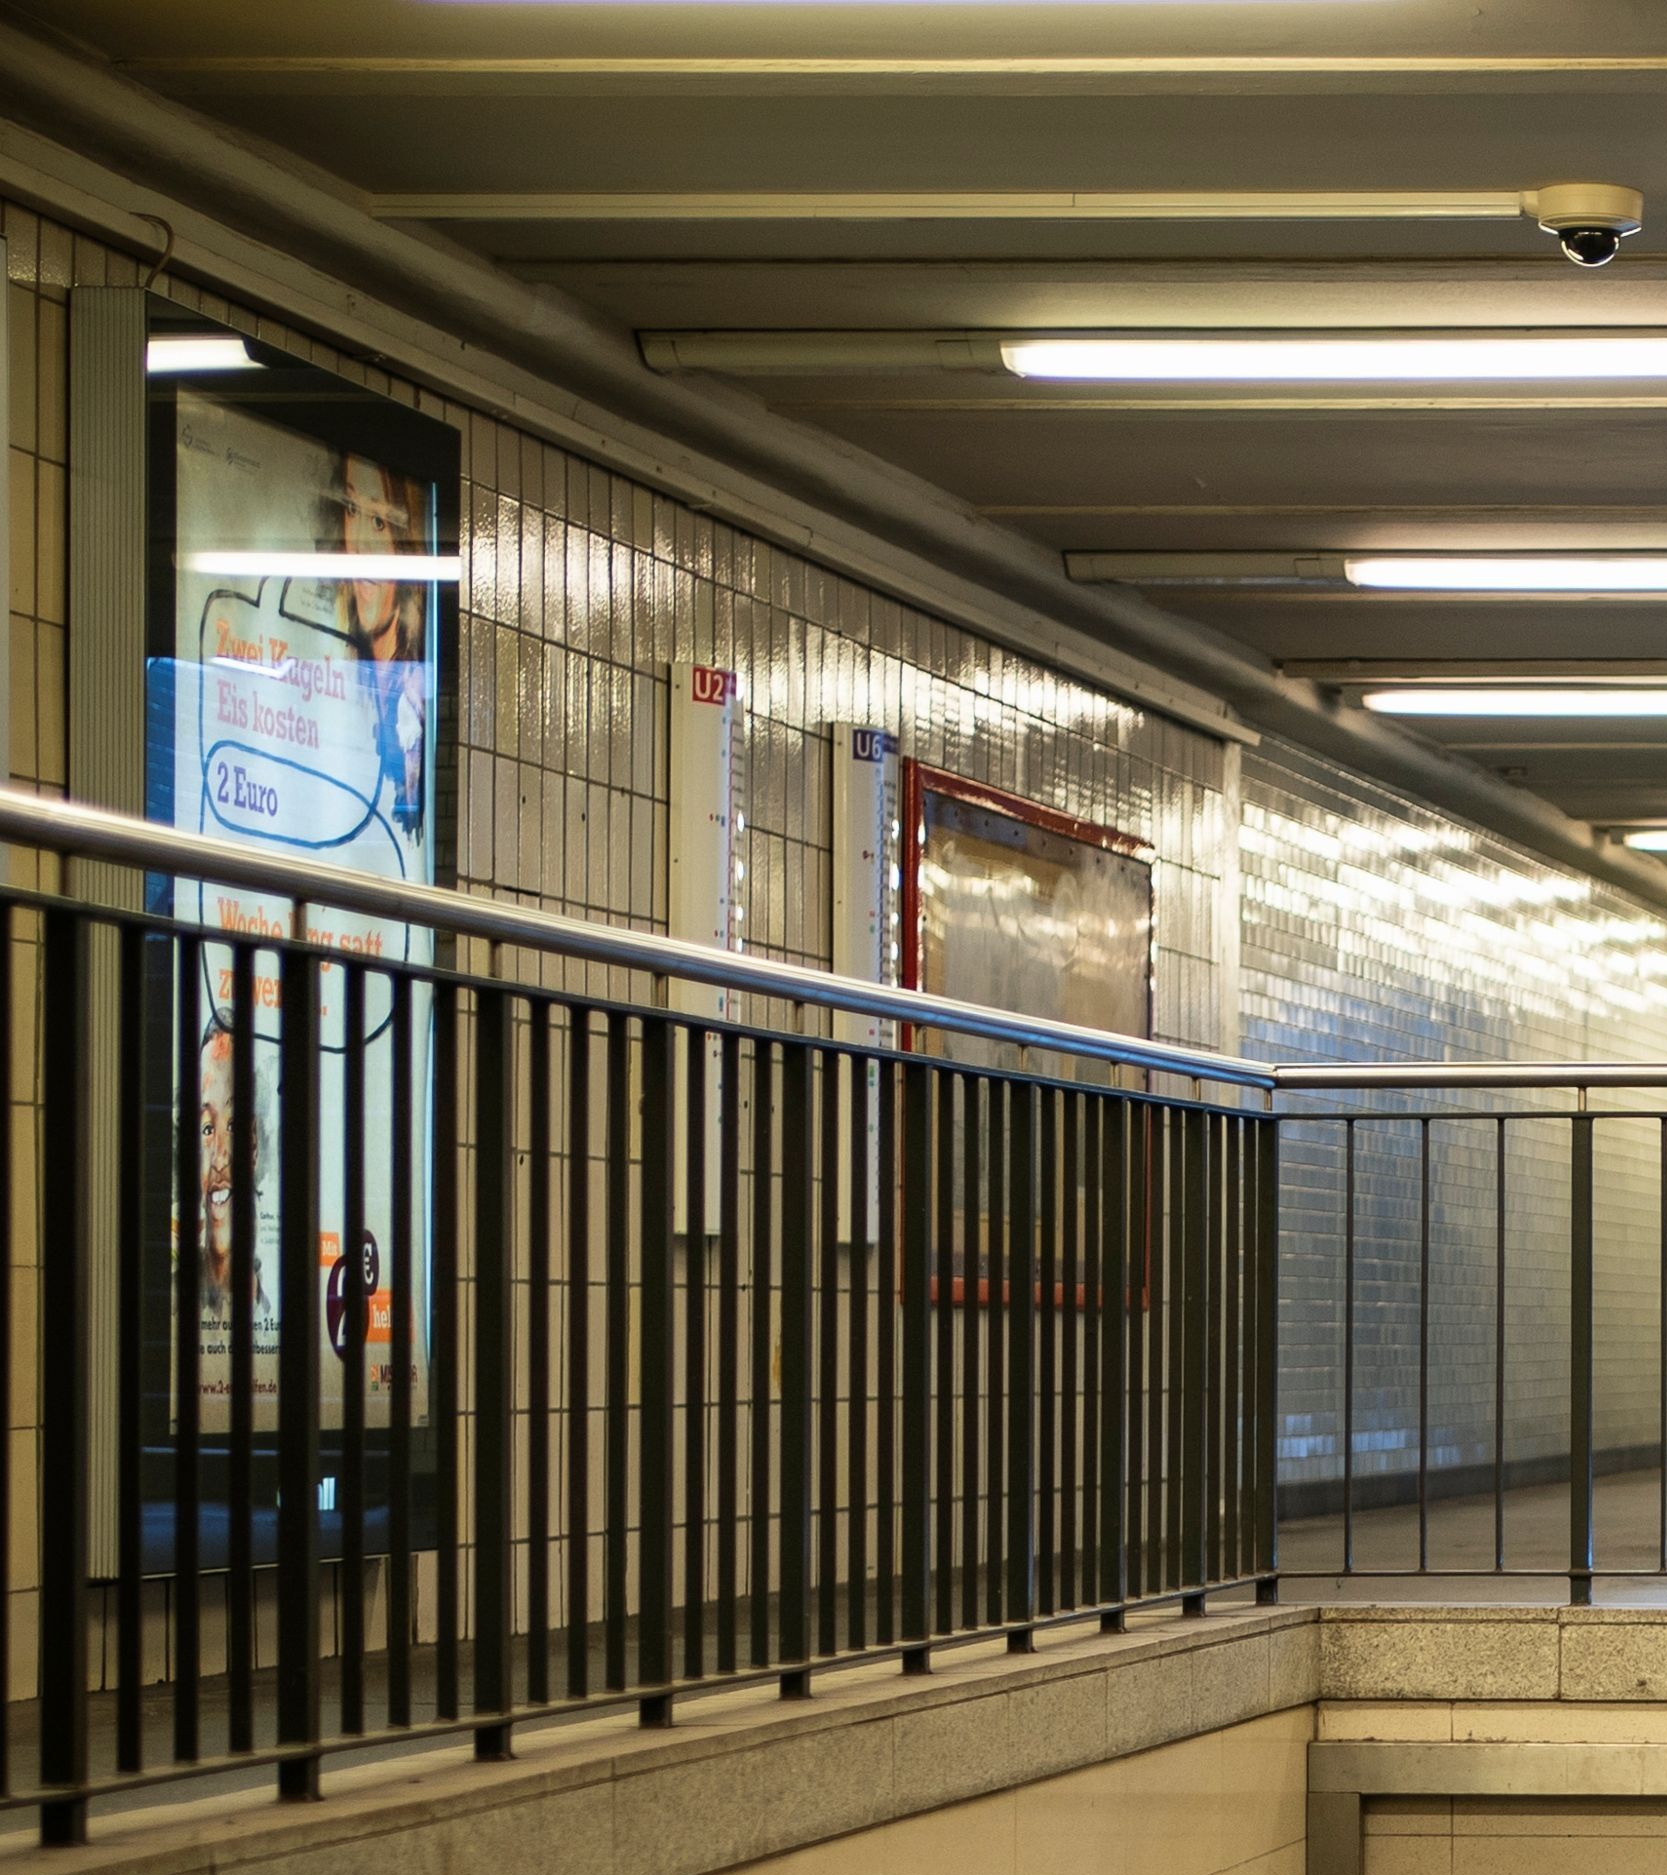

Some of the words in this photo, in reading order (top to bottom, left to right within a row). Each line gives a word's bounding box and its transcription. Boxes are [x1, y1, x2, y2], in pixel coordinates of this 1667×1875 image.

[694, 671, 724, 701] U2
[217, 678, 248, 730] Eis
[252, 691, 319, 749] kosten
[856, 732, 882, 760] U6
[217, 761, 229, 804] 2
[233, 765, 278, 817] Euro
